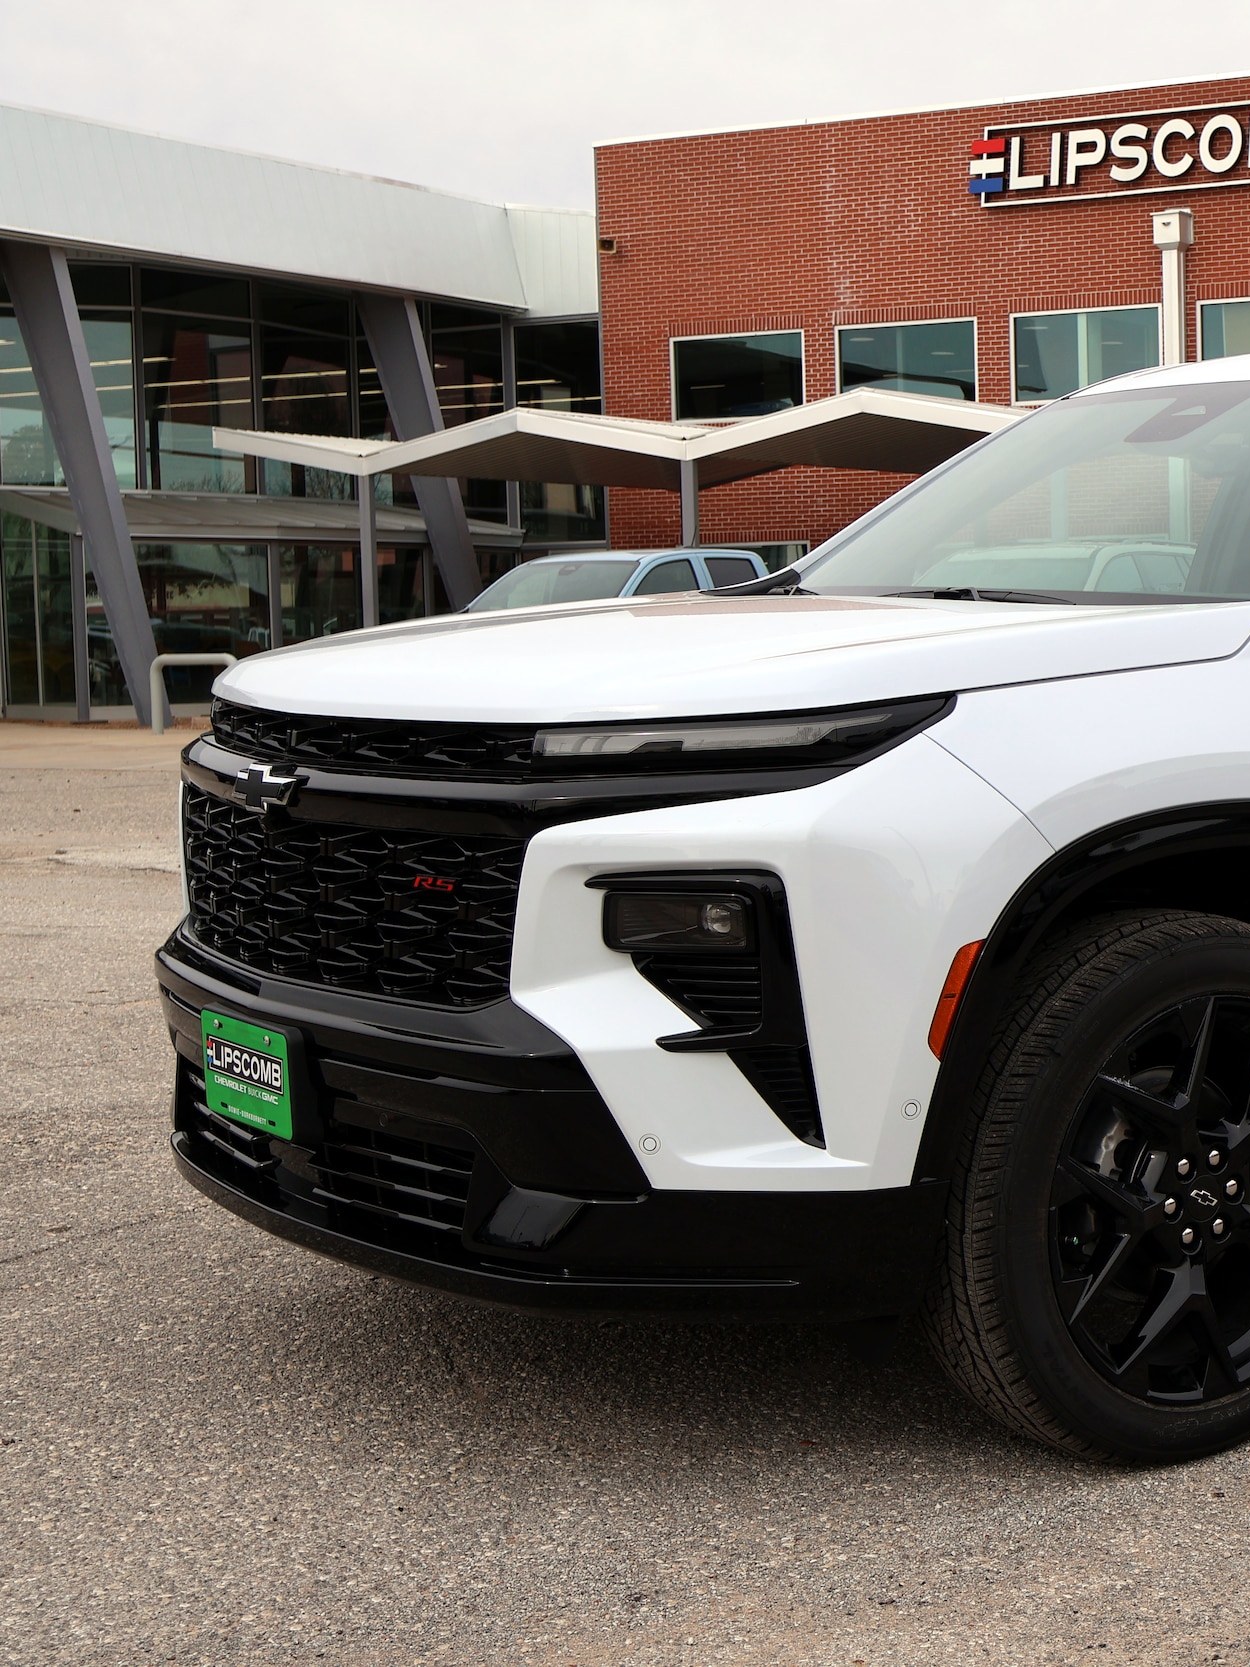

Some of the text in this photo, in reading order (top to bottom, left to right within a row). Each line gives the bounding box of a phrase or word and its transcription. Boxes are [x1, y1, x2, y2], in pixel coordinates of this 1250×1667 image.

[413, 875, 456, 892] RS
[212, 1042, 281, 1088] LIPSCOMB
[214, 1075, 247, 1094] CHEVROLET
[262, 1092, 279, 1105] GMC
